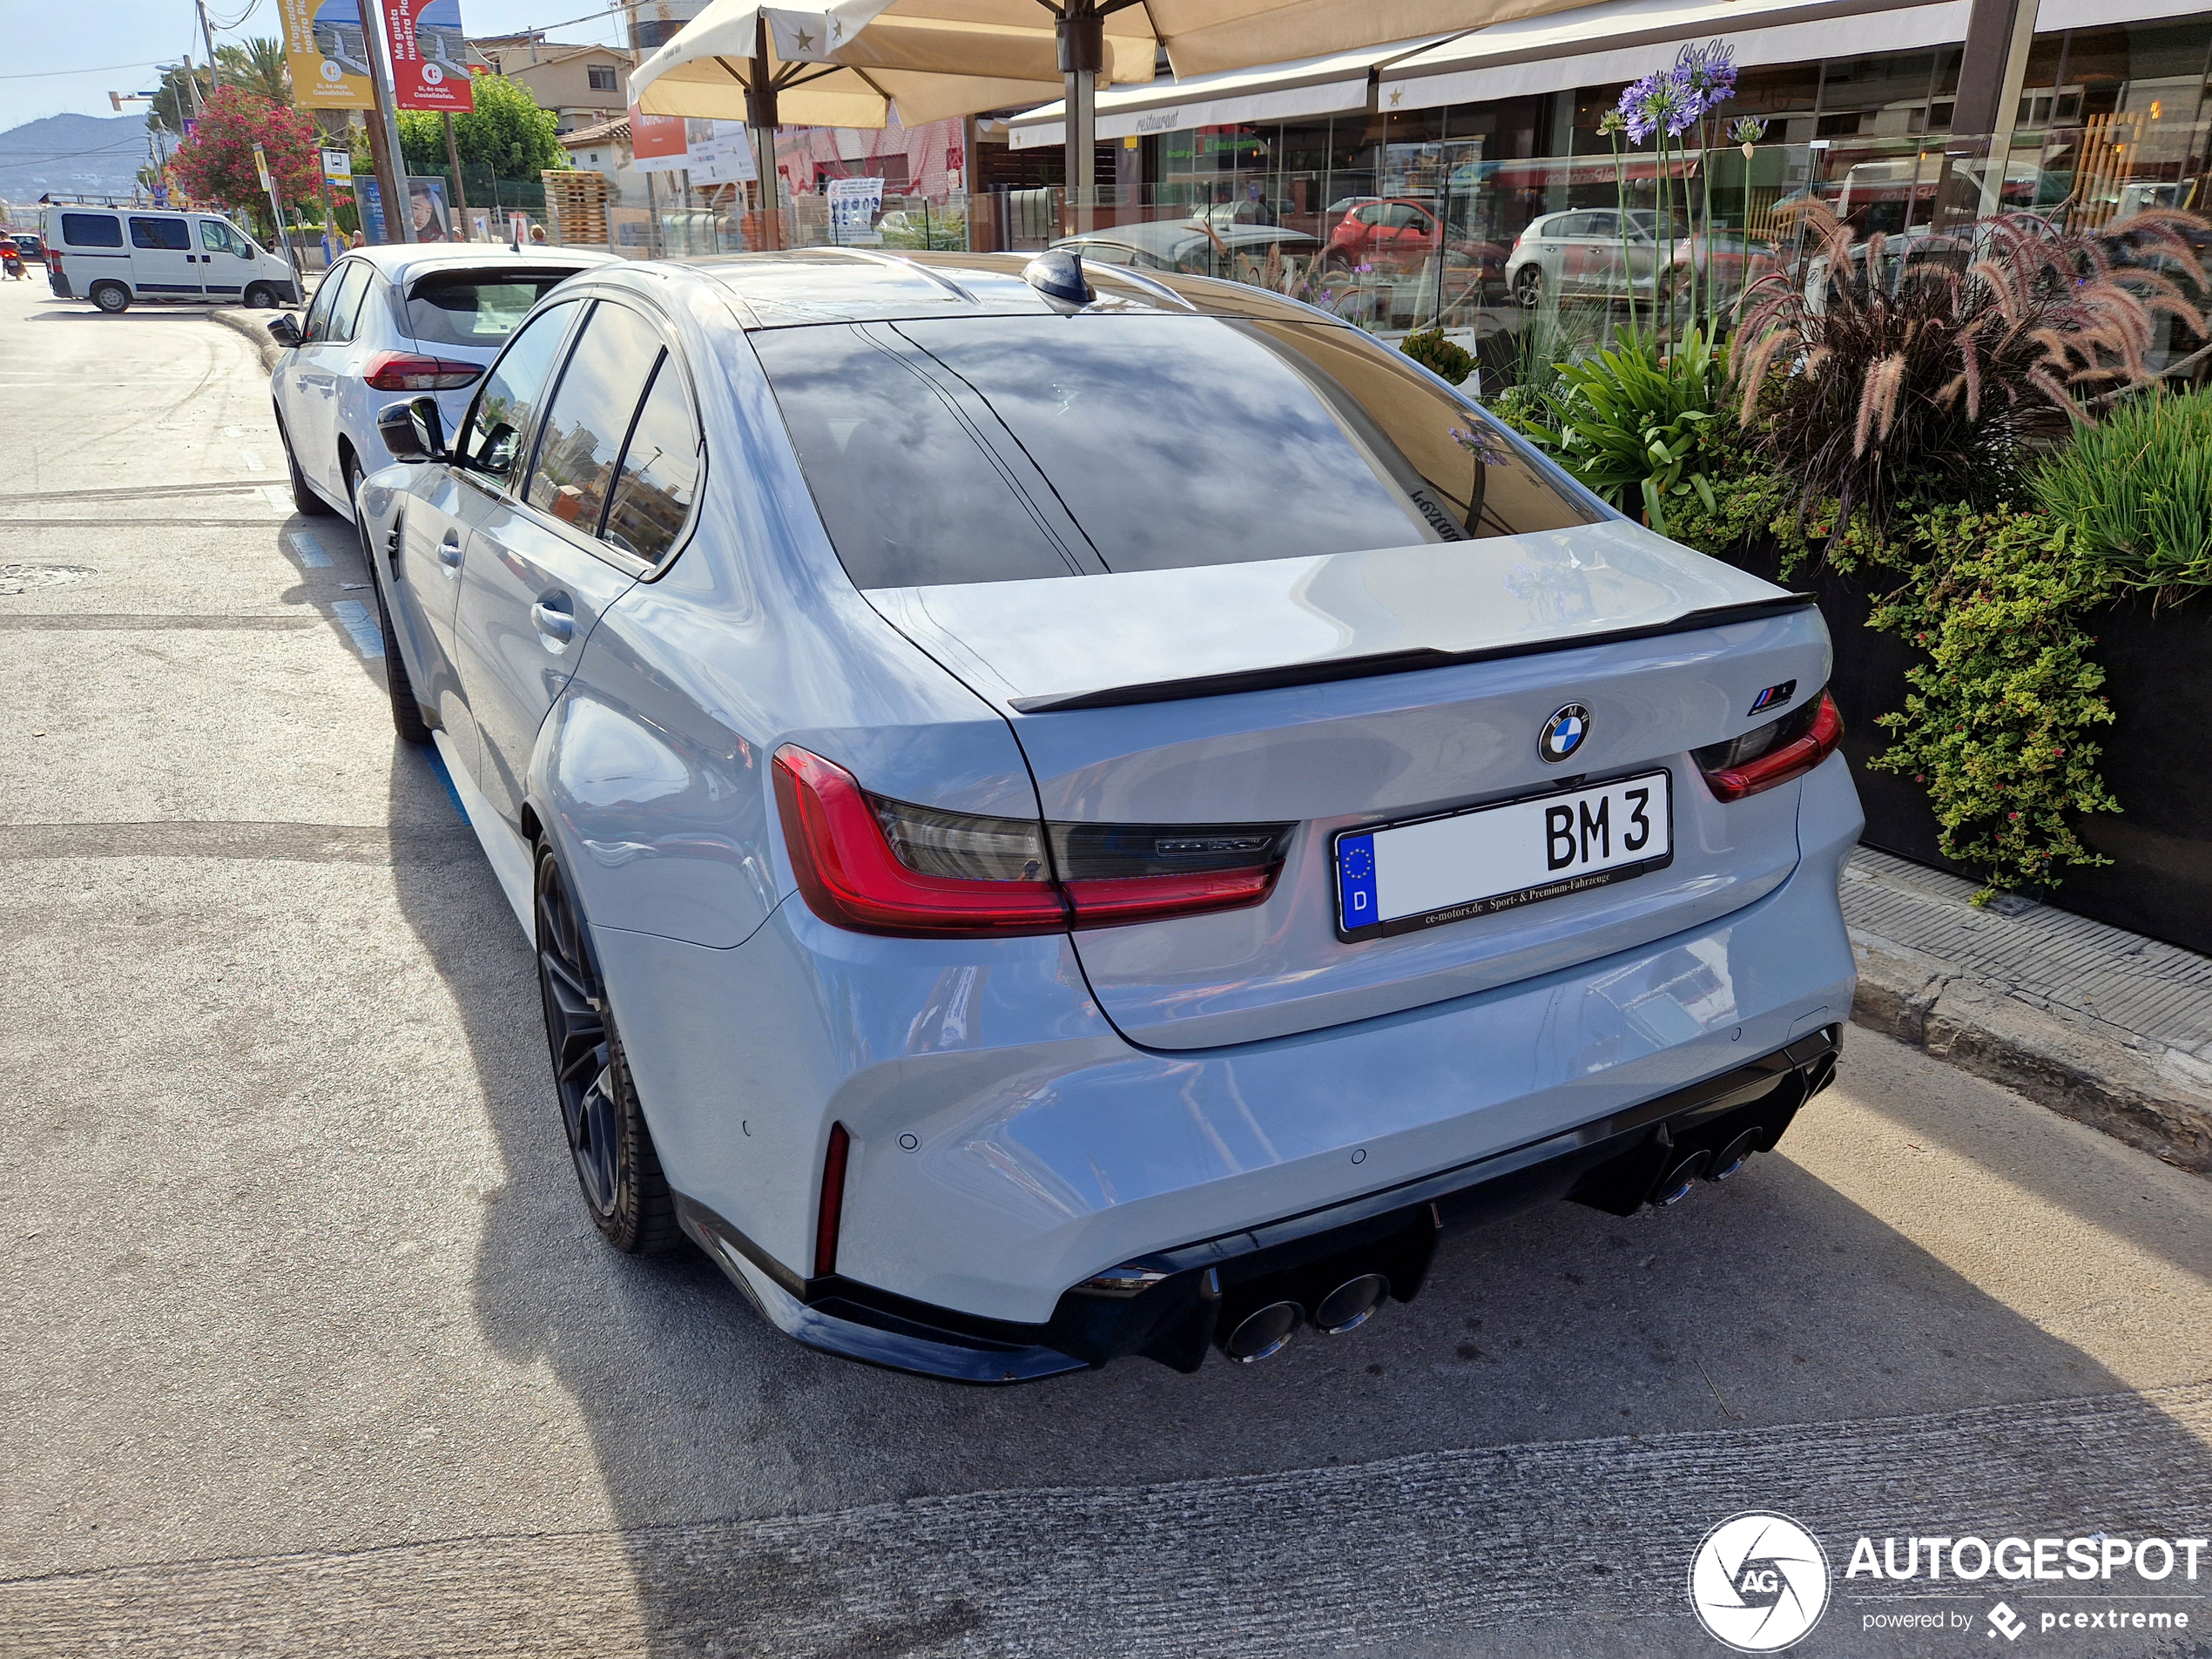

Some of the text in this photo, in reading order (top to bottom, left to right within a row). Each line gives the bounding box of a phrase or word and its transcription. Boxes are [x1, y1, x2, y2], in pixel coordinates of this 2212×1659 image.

[301, 17, 314, 54] nostra
[390, 9, 405, 60] Me gusta
[402, 18, 416, 61] nuestra
[1136, 110, 1179, 132] restaurant
[1550, 705, 1589, 728] BMW
[1545, 786, 1649, 871] BM 3
[1353, 890, 1367, 911] D
[1425, 872, 1611, 924] ce-motors.de Sport- & Premium-Fahrzeuge
